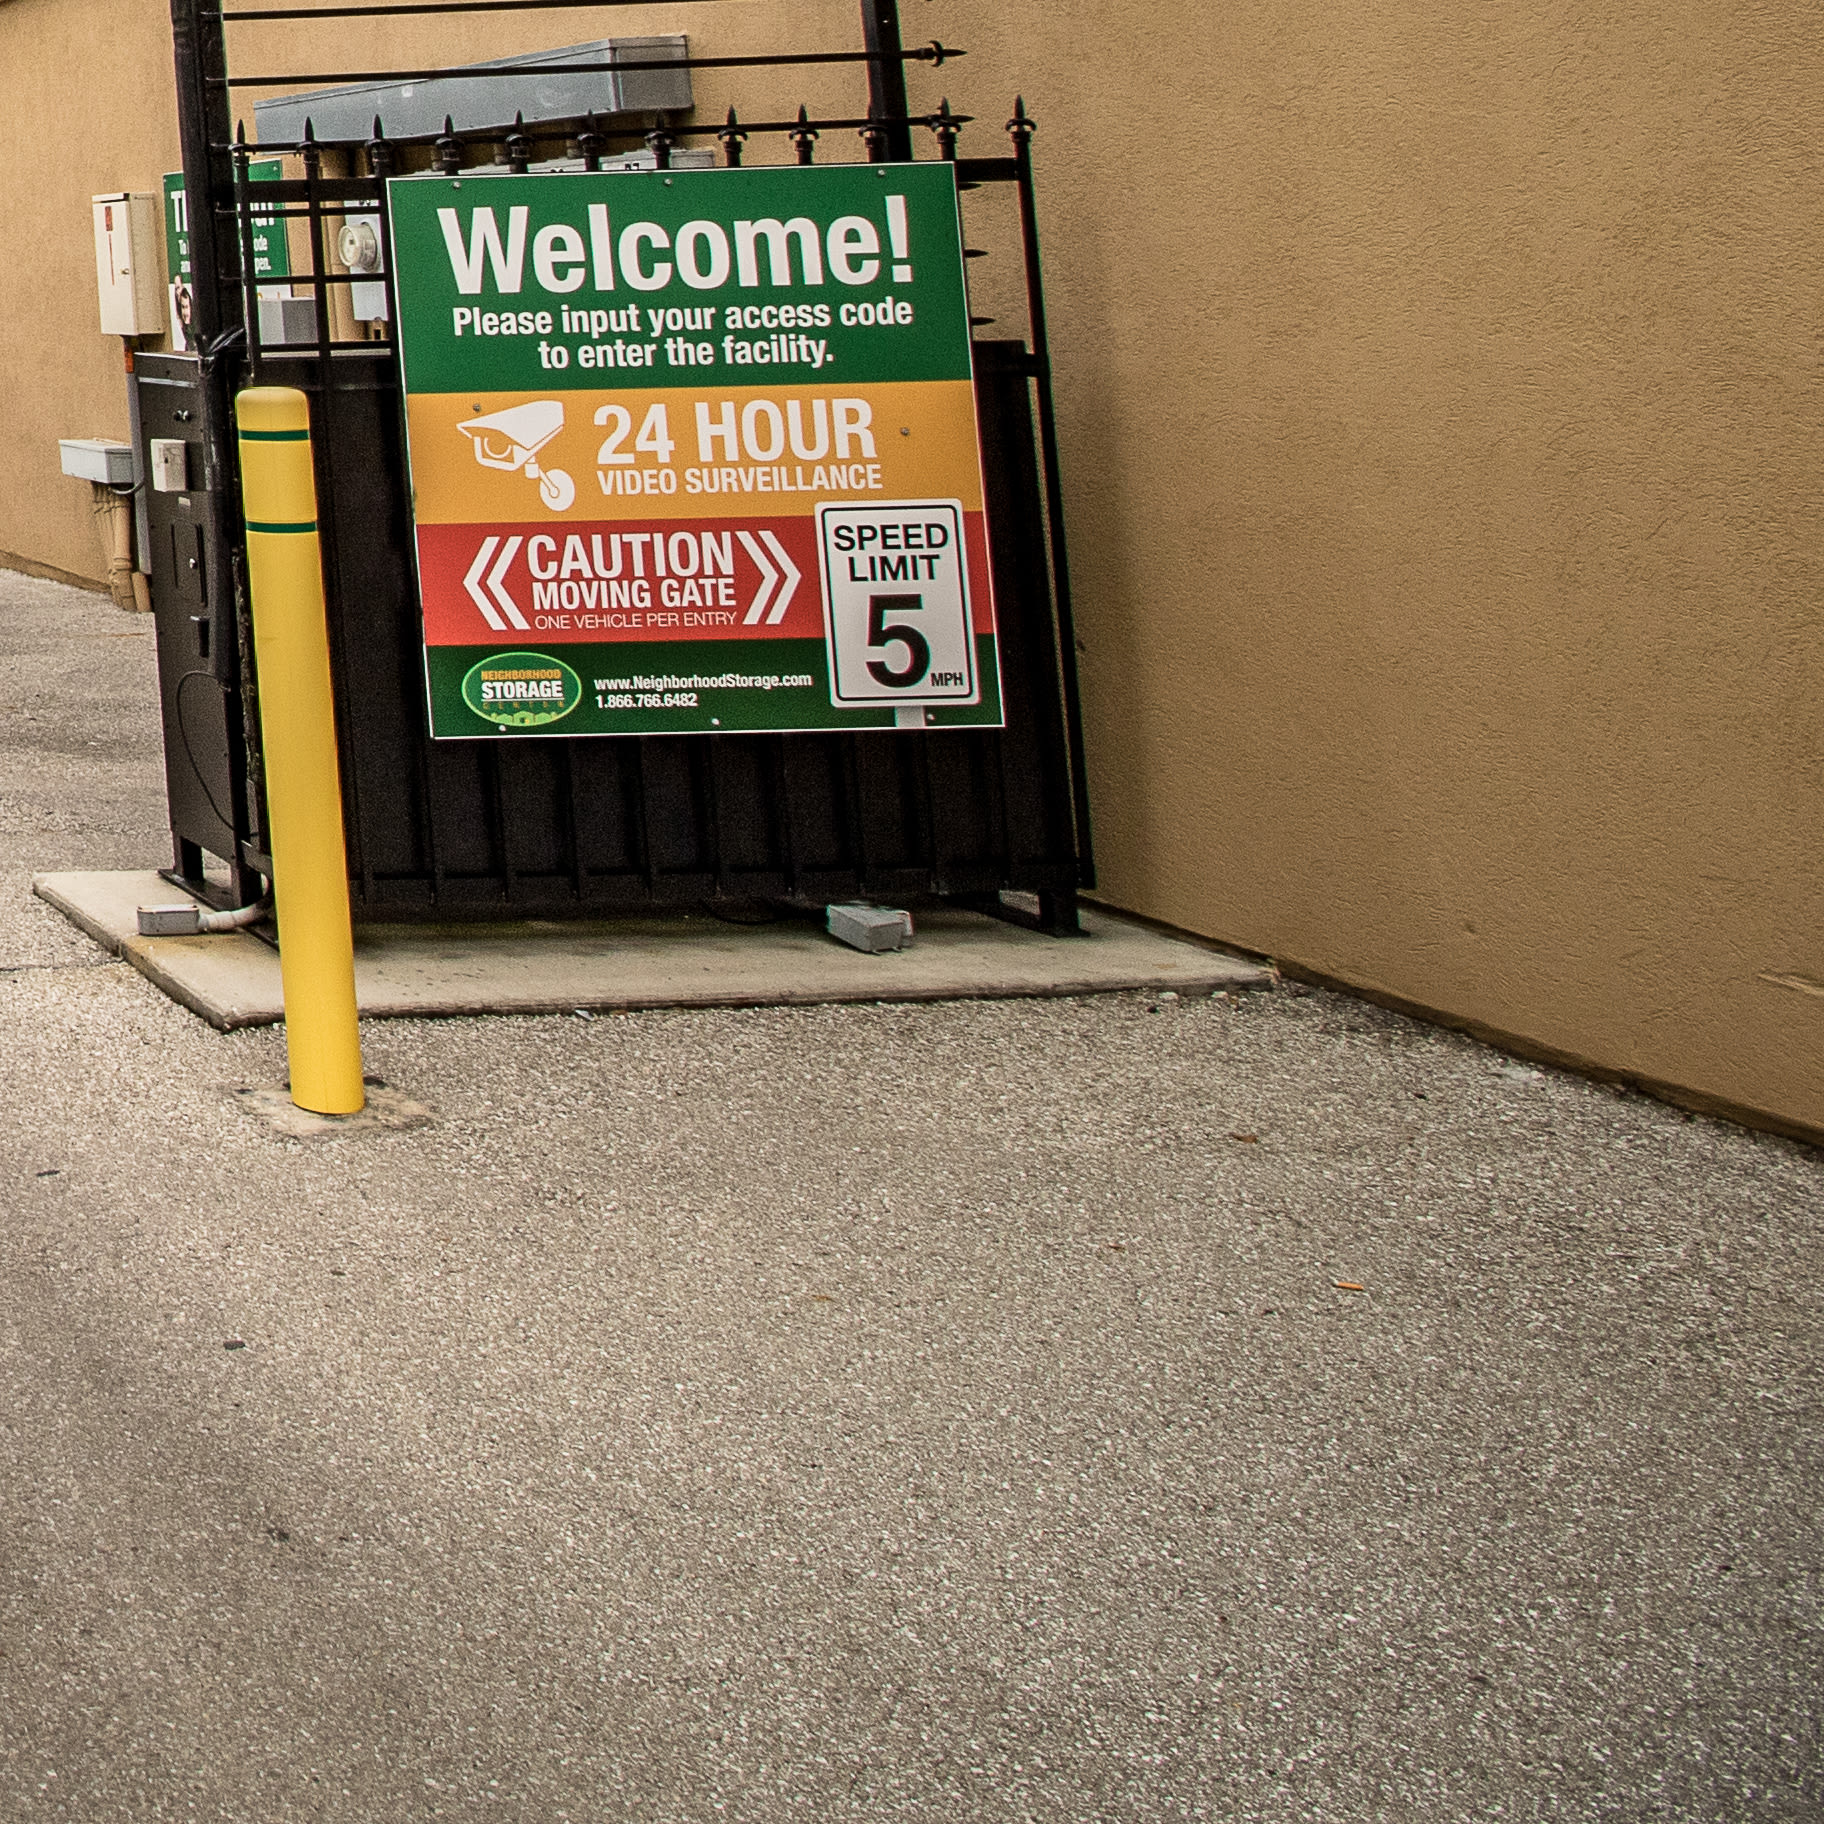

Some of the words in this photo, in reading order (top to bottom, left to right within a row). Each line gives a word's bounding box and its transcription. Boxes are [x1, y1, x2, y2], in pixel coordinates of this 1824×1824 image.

[437, 195, 913, 294] Welcome!
[453, 306, 552, 336] Please
[561, 304, 642, 339] input
[647, 307, 716, 338] your
[724, 303, 832, 329] access
[839, 296, 914, 326] code
[538, 341, 570, 369] to
[577, 339, 657, 368] enter
[664, 336, 715, 366] the
[722, 334, 834, 368] facility.
[593, 403, 675, 465] 24
[695, 398, 878, 462] HOUR
[596, 468, 677, 495] VIDEO
[684, 464, 883, 493] SURVEILLANCE
[834, 523, 949, 551] SPEED
[527, 531, 735, 580] CAUTION
[848, 554, 940, 582] LIMIT
[532, 579, 651, 610] MOVING
[660, 578, 737, 608] GATE
[534, 615, 571, 630] ONE
[574, 613, 643, 629] VEHICLE
[647, 613, 679, 627] PER
[684, 611, 737, 626] ENTRY
[865, 593, 931, 688] 5
[481, 669, 562, 681] NEIGHBORHOOD
[481, 680, 564, 699] STORAGE
[594, 673, 813, 692] www.NeighborhoodStorage.com
[930, 672, 964, 687] MPH
[595, 692, 699, 709] 1.866.766.6482
